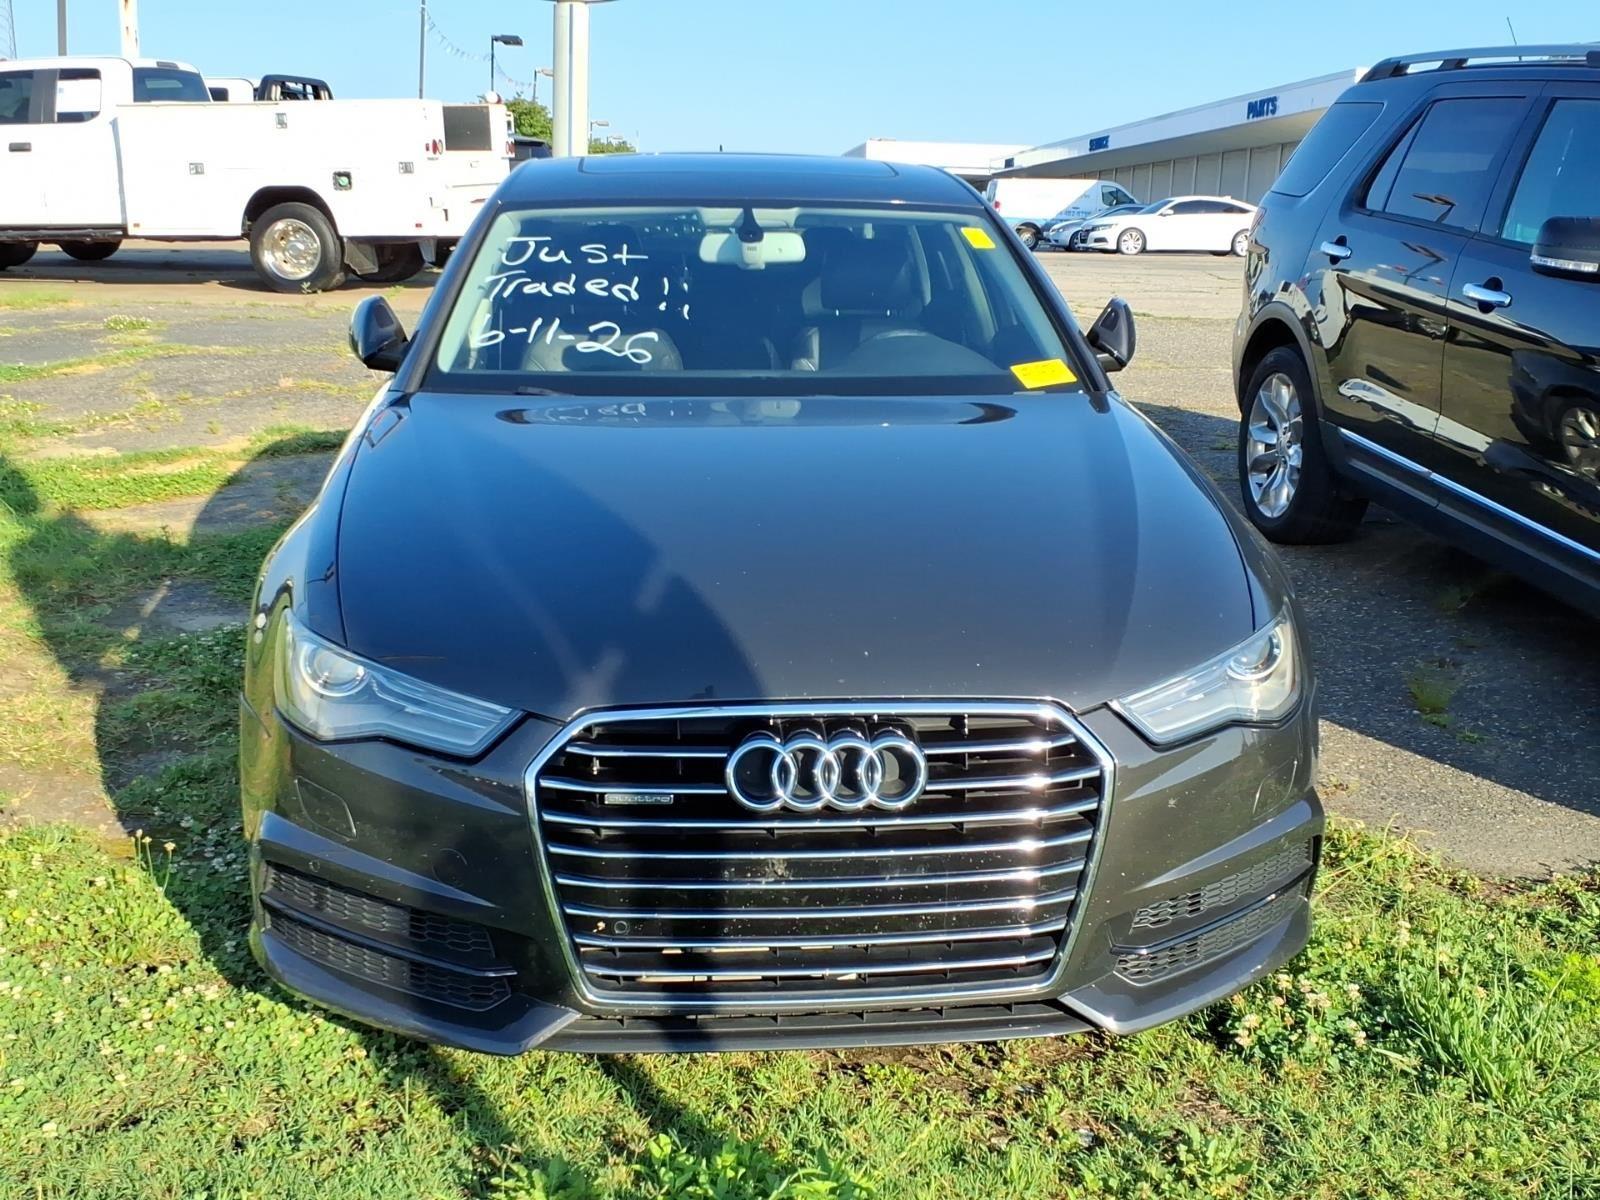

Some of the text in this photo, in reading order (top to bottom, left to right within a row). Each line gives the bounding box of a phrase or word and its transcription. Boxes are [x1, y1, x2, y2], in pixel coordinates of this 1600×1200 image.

[1246, 95, 1278, 120] PARTS
[501, 236, 649, 266] Just
[468, 313, 659, 364] 6-11-26
[607, 794, 671, 803] quattro
